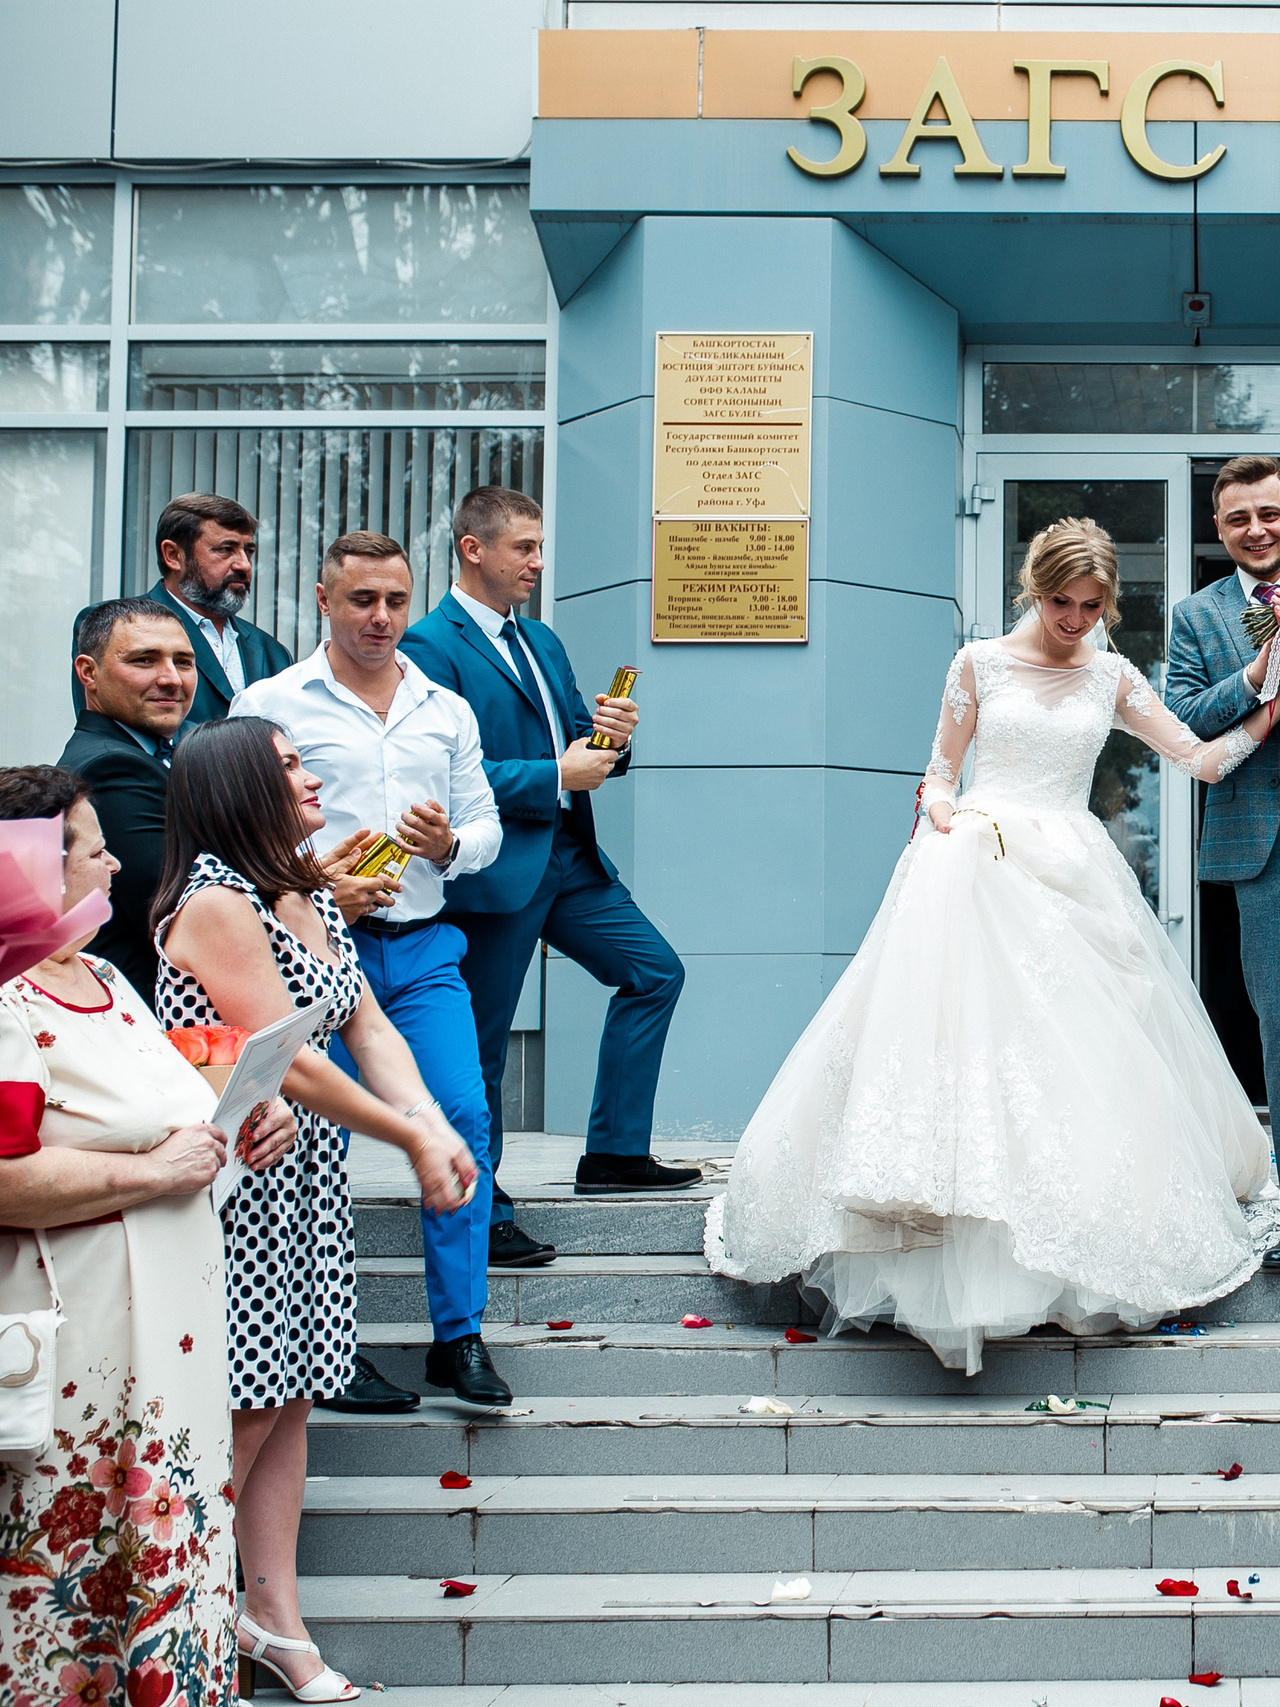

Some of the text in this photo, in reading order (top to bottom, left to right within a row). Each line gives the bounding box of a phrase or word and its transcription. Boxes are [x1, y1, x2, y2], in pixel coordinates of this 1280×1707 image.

[786, 55, 1227, 181] ЗАГС
[663, 363, 713, 371] ЮСТИЦИЯ
[758, 362, 805, 371] БУЙЫНСА
[666, 432, 754, 442] Государственный
[665, 445, 799, 455] Республики Башкортостан
[702, 472, 733, 480] Отдел
[704, 485, 760, 493] Советского
[697, 498, 733, 508] района
[745, 498, 765, 508] Уфа
[682, 584, 780, 593] РЕЖИМ РАБОТЫ:
[668, 605, 703, 613] Перерыв
